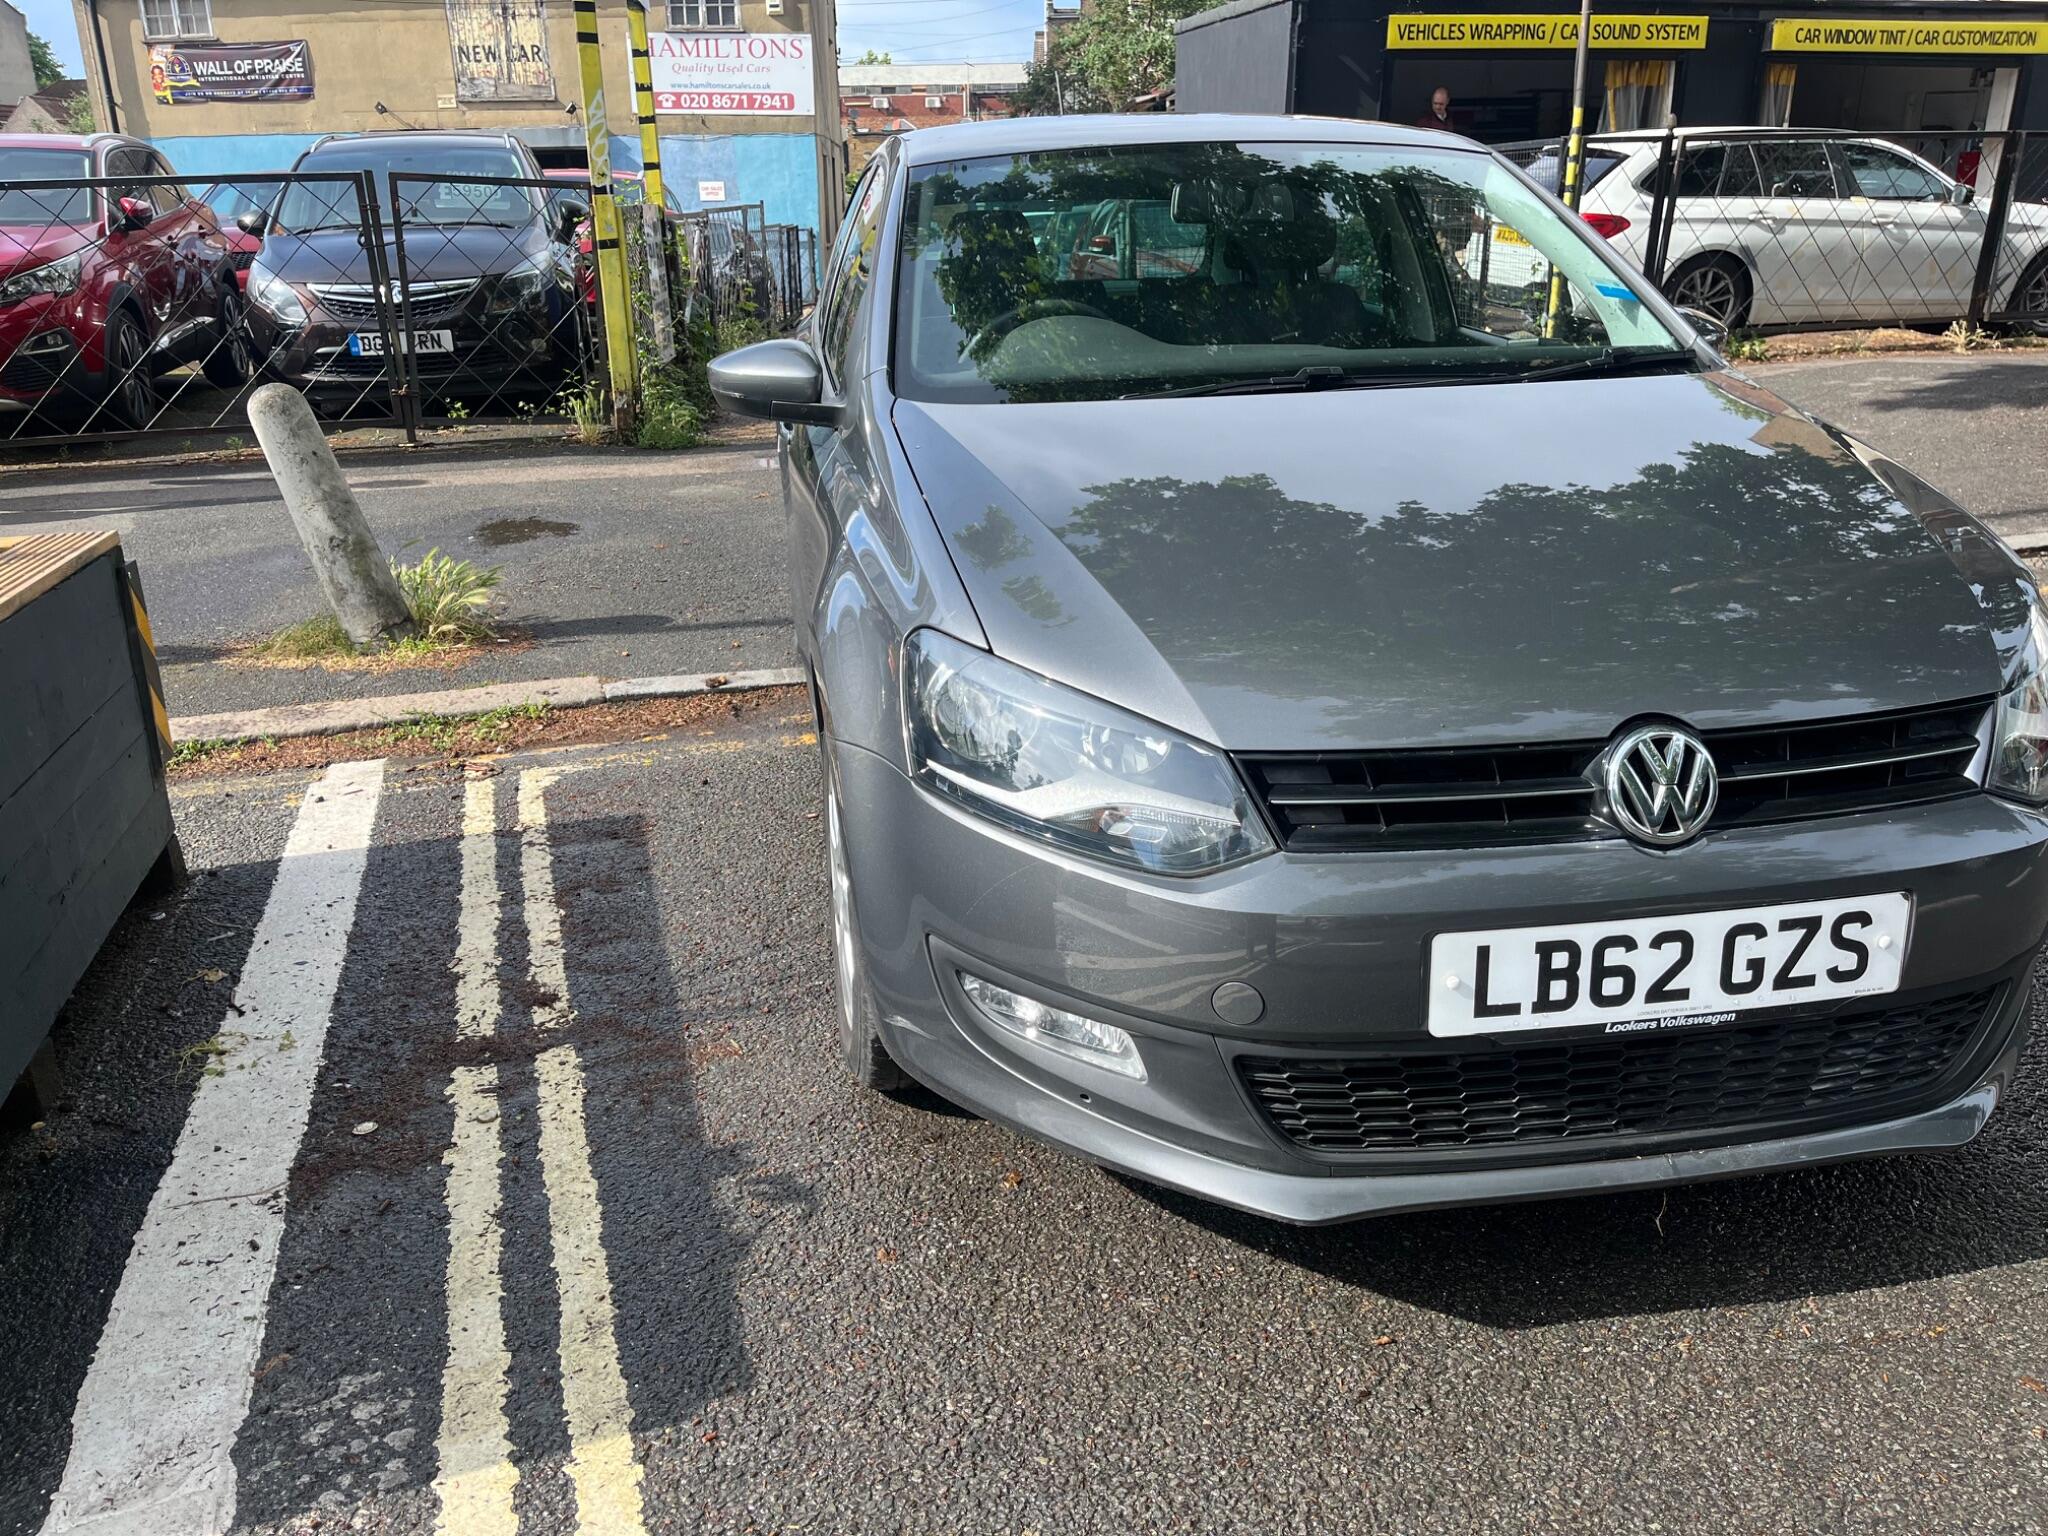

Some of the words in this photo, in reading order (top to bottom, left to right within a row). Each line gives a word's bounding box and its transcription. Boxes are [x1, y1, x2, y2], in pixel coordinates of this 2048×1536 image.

[1397, 23, 1466, 41] VEHICLES
[1469, 23, 1546, 41] WRAPPING
[1549, 22, 1558, 44] /
[1560, 23, 1580, 41] CA
[1592, 23, 1641, 41] SOUND
[1645, 23, 1700, 41] SYSTEM
[1795, 27, 1822, 44] CAR
[1823, 28, 1877, 45] WINDOW
[1879, 29, 1906, 45] TINT
[1915, 29, 1940, 46] CAR
[1942, 30, 2037, 47] CUSTOMIZATION
[457, 44, 498, 63] NEW
[193, 60, 233, 76] WALL
[234, 60, 254, 75] OF
[254, 57, 304, 74] PRAISE
[671, 62, 714, 74] Quality
[717, 63, 743, 73] Used
[746, 63, 771, 73] Cars
[670, 82, 771, 90] www.hamiltonscarsales.co.uk
[680, 94, 709, 108] 020
[711, 94, 750, 108] 8671
[752, 95, 789, 109] 7941
[413, 332, 443, 351] RN
[1472, 928, 1696, 1019] LB62
[1719, 910, 1874, 997] GZS
[1604, 1020, 1658, 1033] Lookers
[1659, 1012, 1737, 1028] Volkswagen
